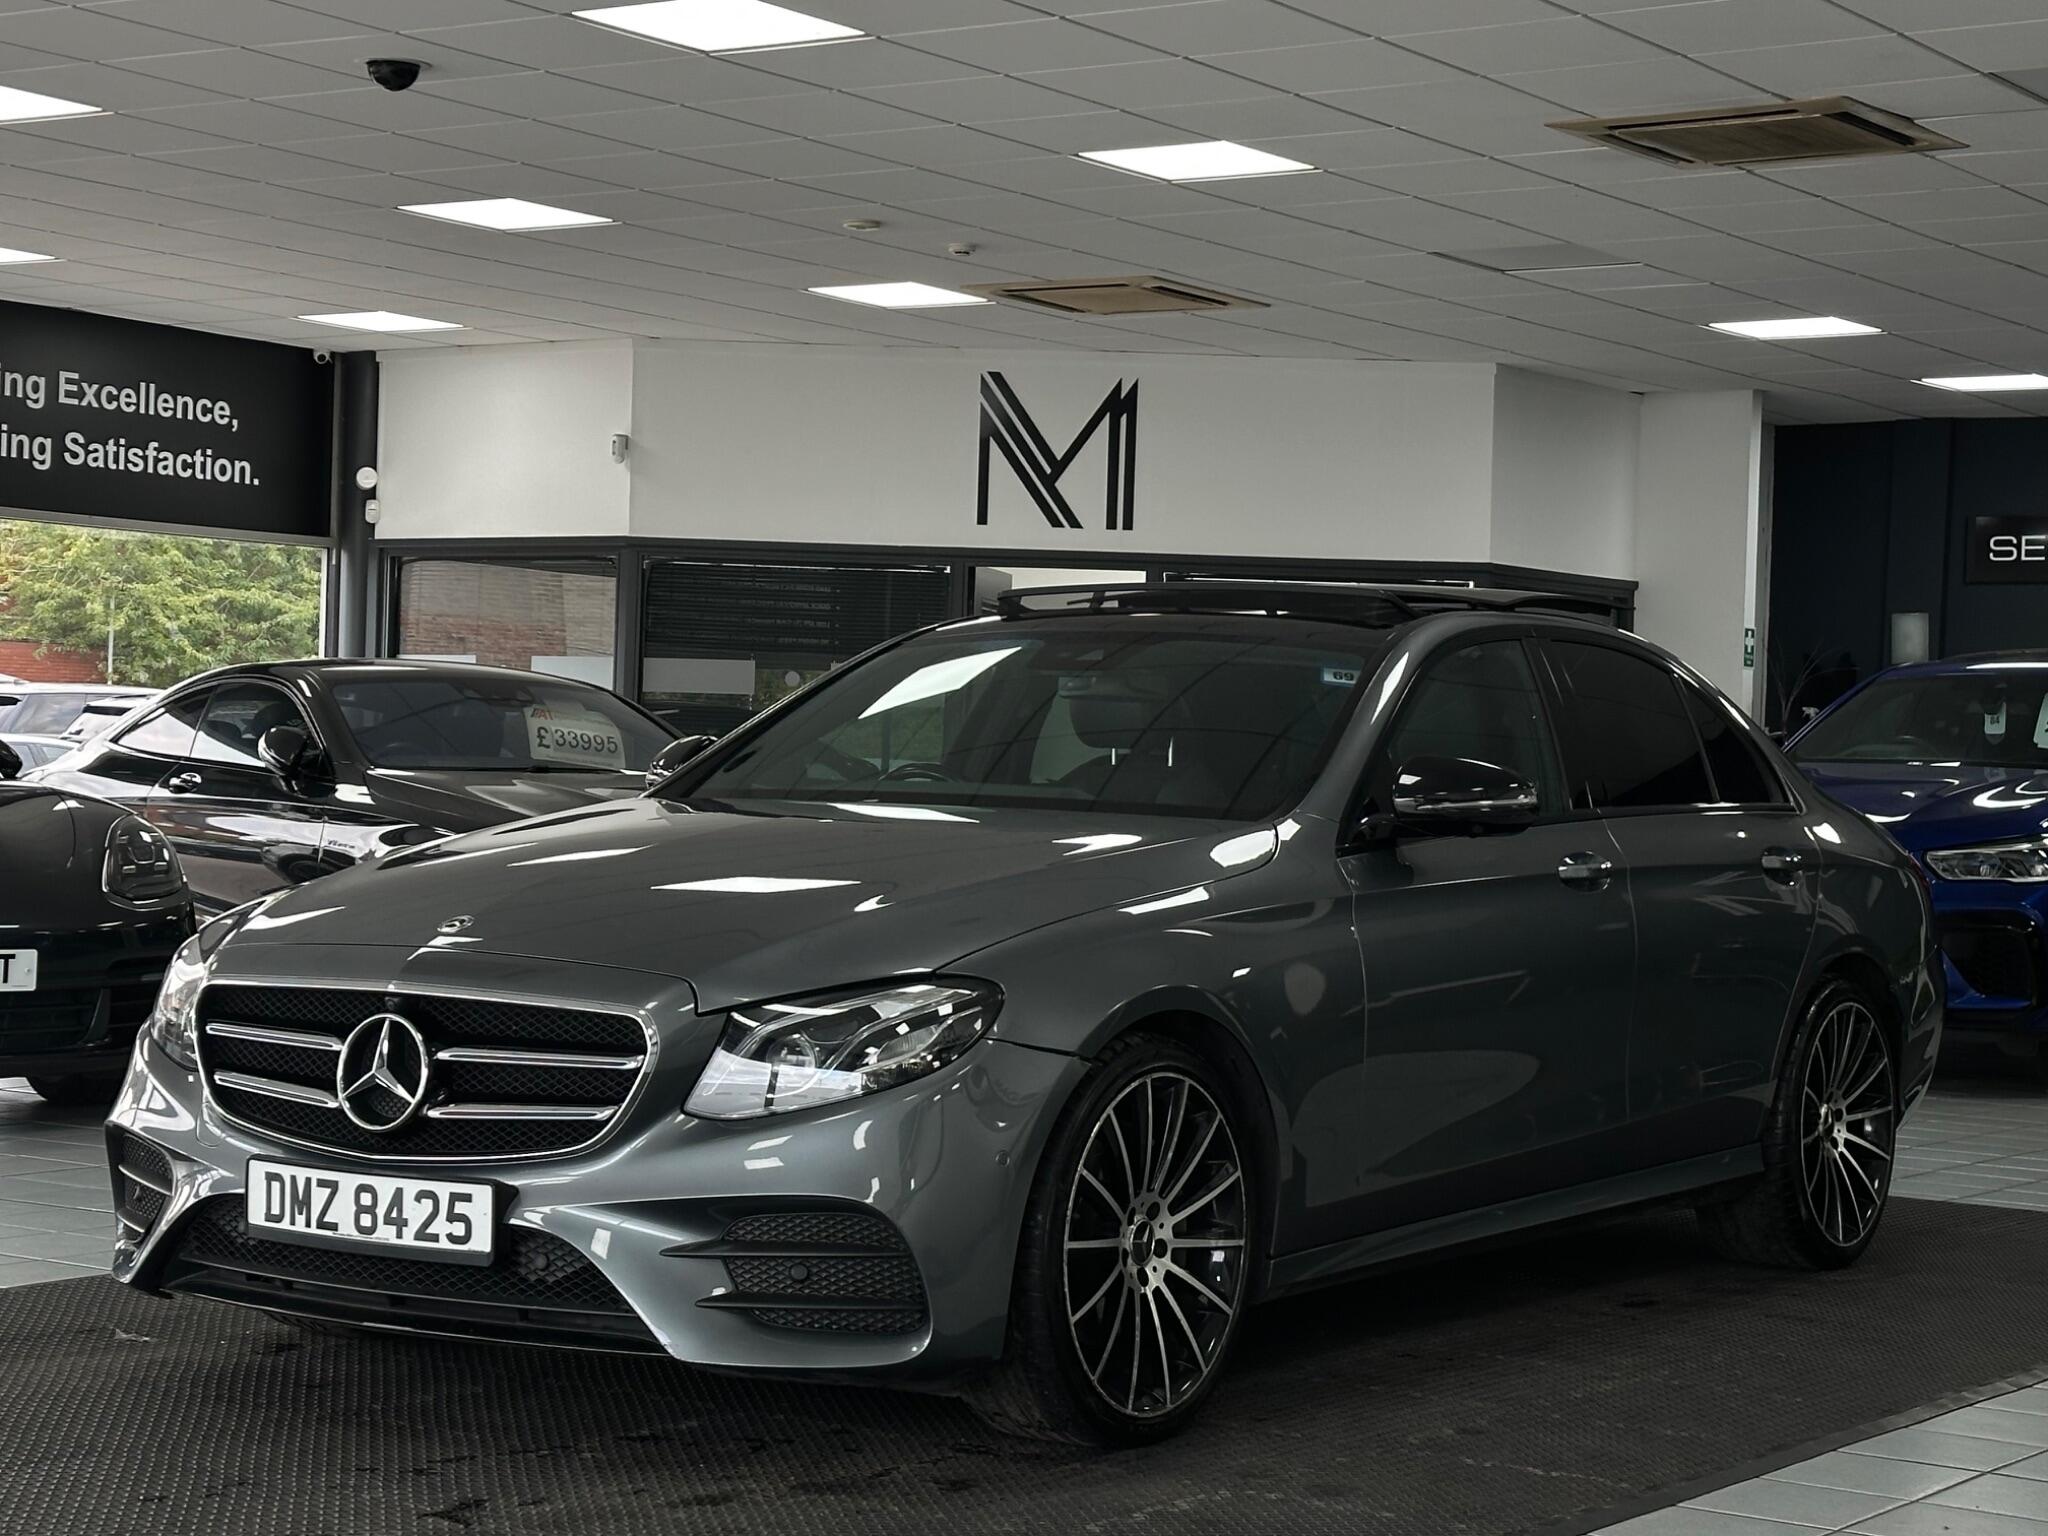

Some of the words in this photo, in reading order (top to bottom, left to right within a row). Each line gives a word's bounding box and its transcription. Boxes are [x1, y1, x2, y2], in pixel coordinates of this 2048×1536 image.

[0, 363, 46, 409] ng
[58, 370, 239, 432] Excellence,
[63, 431, 260, 485] Satisfaction.
[536, 726, 618, 754] £33995
[264, 1171, 339, 1232] DMZ
[354, 1183, 473, 1245] 8425
